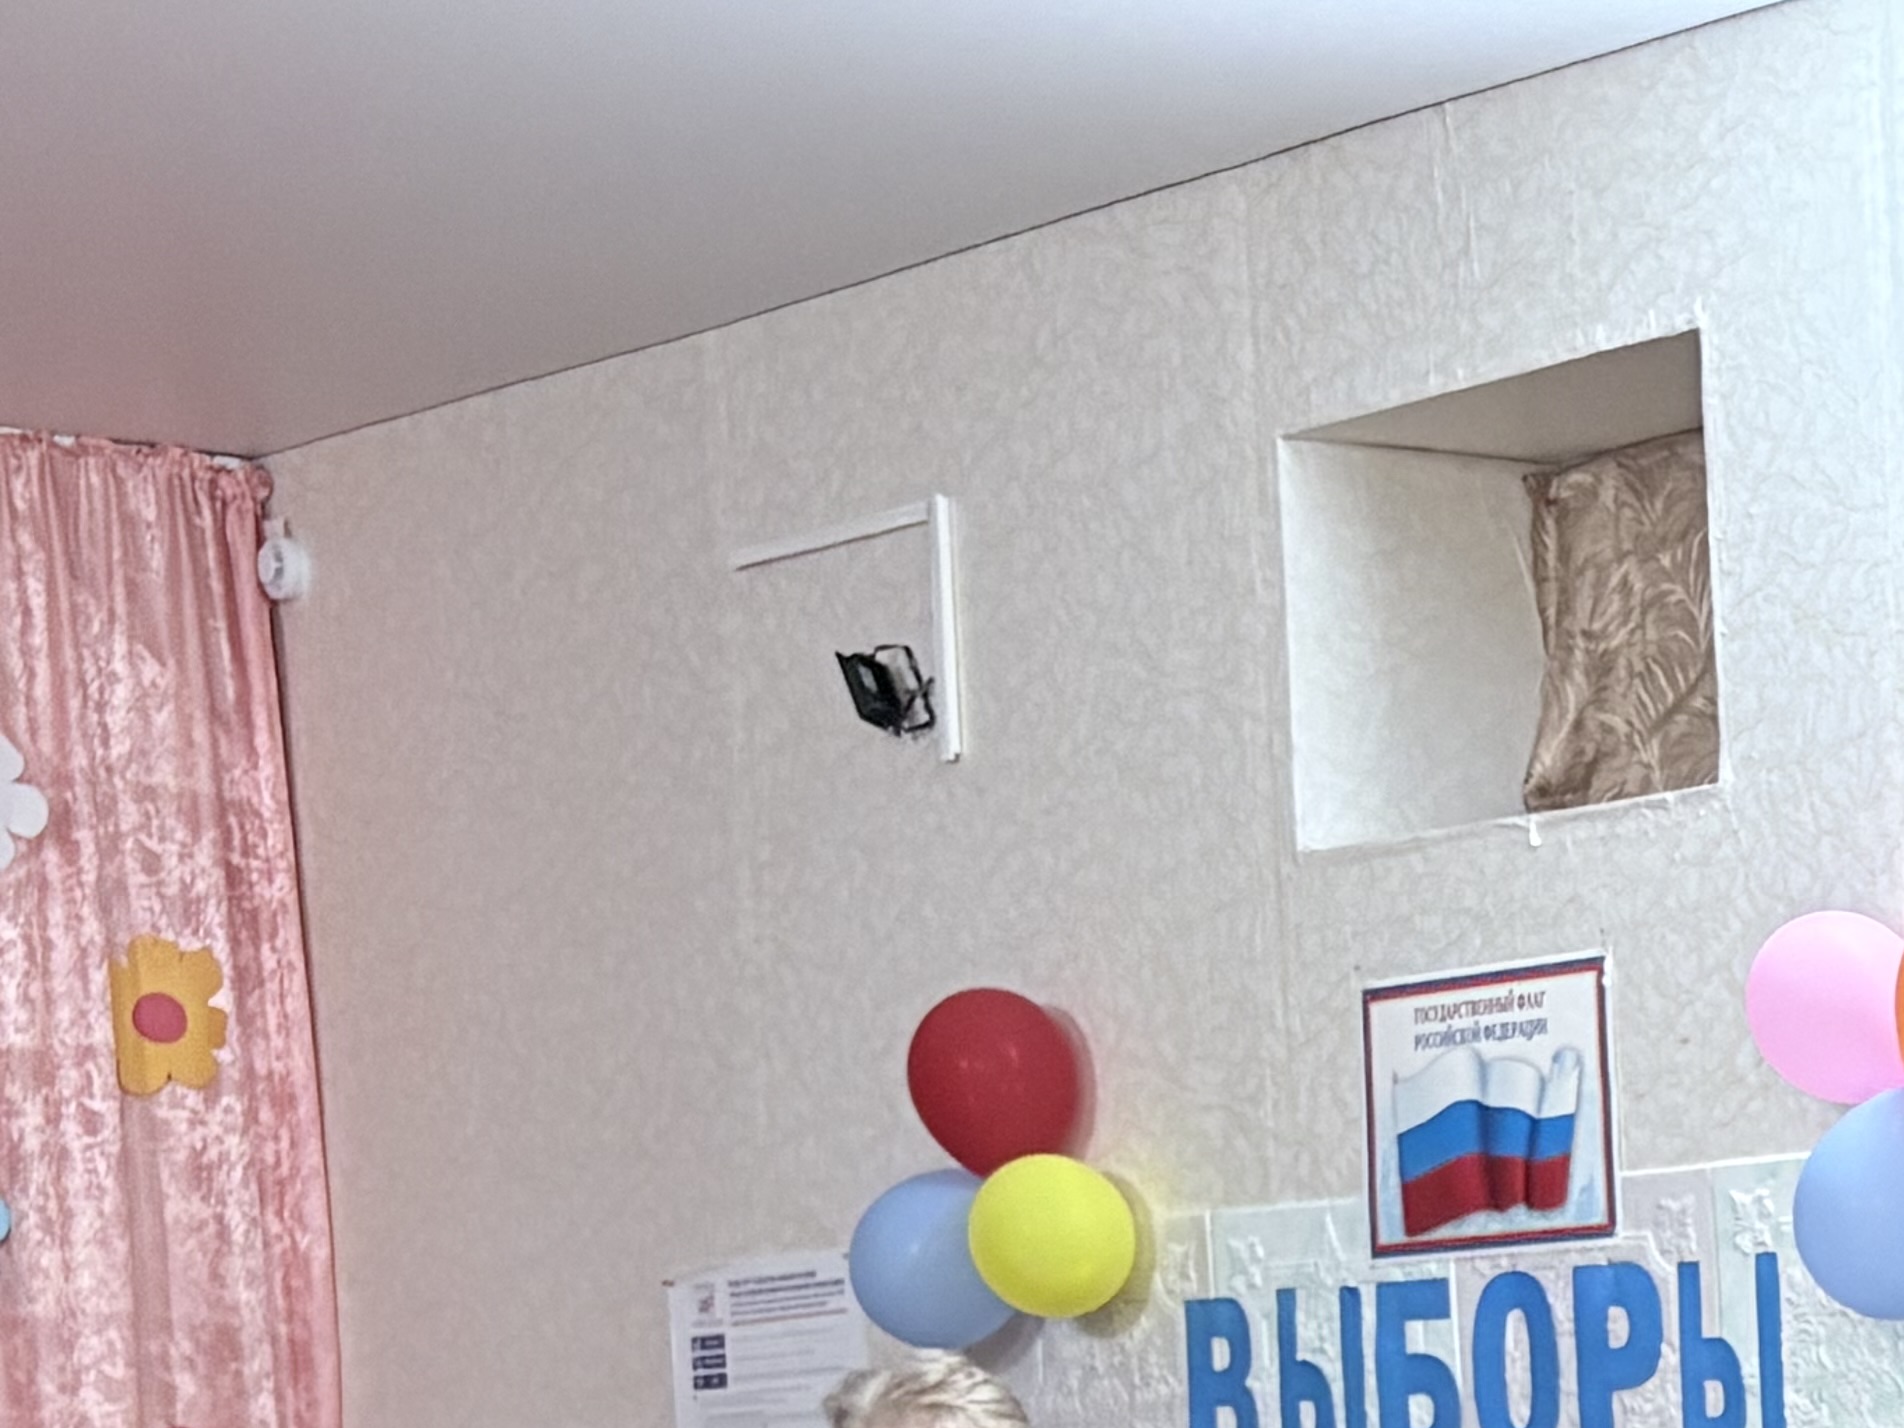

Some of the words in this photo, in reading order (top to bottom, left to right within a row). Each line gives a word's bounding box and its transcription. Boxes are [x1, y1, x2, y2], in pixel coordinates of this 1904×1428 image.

[1414, 988, 1515, 1026] ГОСУДАРСТВЕННЫЙ
[1414, 1020, 1483, 1051] РОССИЙСКОЙ
[1484, 1018, 1548, 1043] ФЕДЕРАЦИИ
